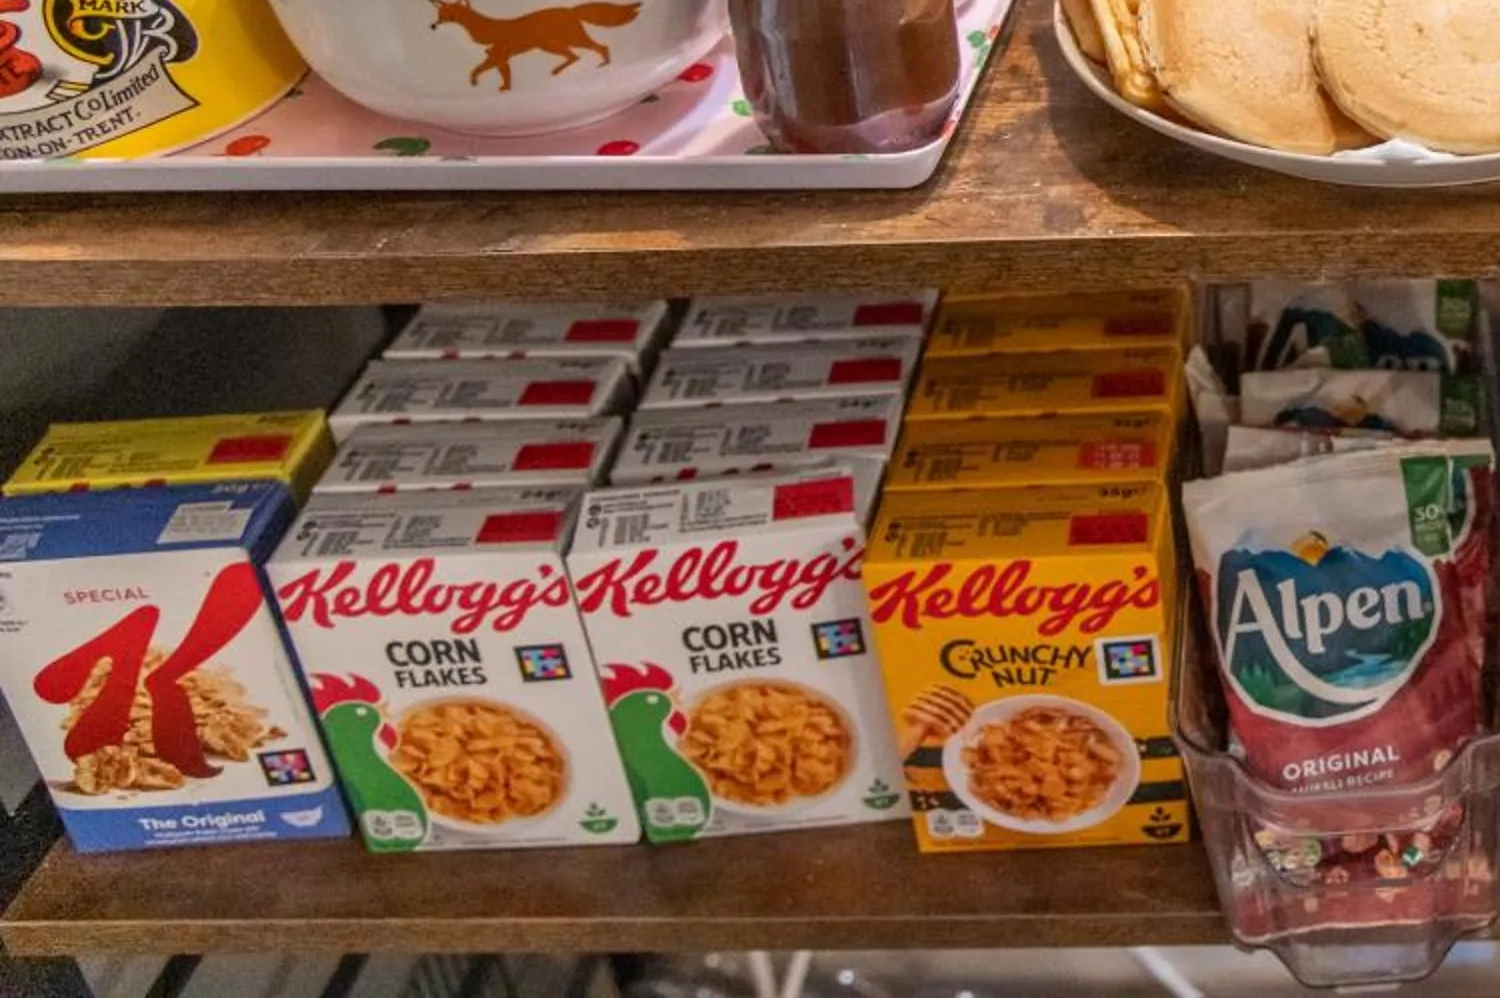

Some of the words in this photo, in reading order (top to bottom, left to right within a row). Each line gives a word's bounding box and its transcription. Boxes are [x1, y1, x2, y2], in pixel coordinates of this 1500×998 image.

[99, 63, 160, 111] Limited
[63, 586, 150, 605] SPECIAL
[278, 557, 570, 634] Kellogg's
[869, 559, 1159, 637] Kellogg's
[384, 638, 482, 667] CORN
[681, 618, 779, 653] CORN
[1223, 568, 1425, 704] Alpen
[33, 561, 266, 778] K
[689, 647, 782, 675] FLAKES
[939, 638, 1092, 679] CRUNCHY
[394, 666, 487, 689] FLAKES
[991, 666, 1056, 689] NUT
[1282, 745, 1400, 781] ORIGINAL
[1347, 769, 1395, 788] RECIPE
[137, 817, 178, 831] The
[181, 810, 267, 829] Original
